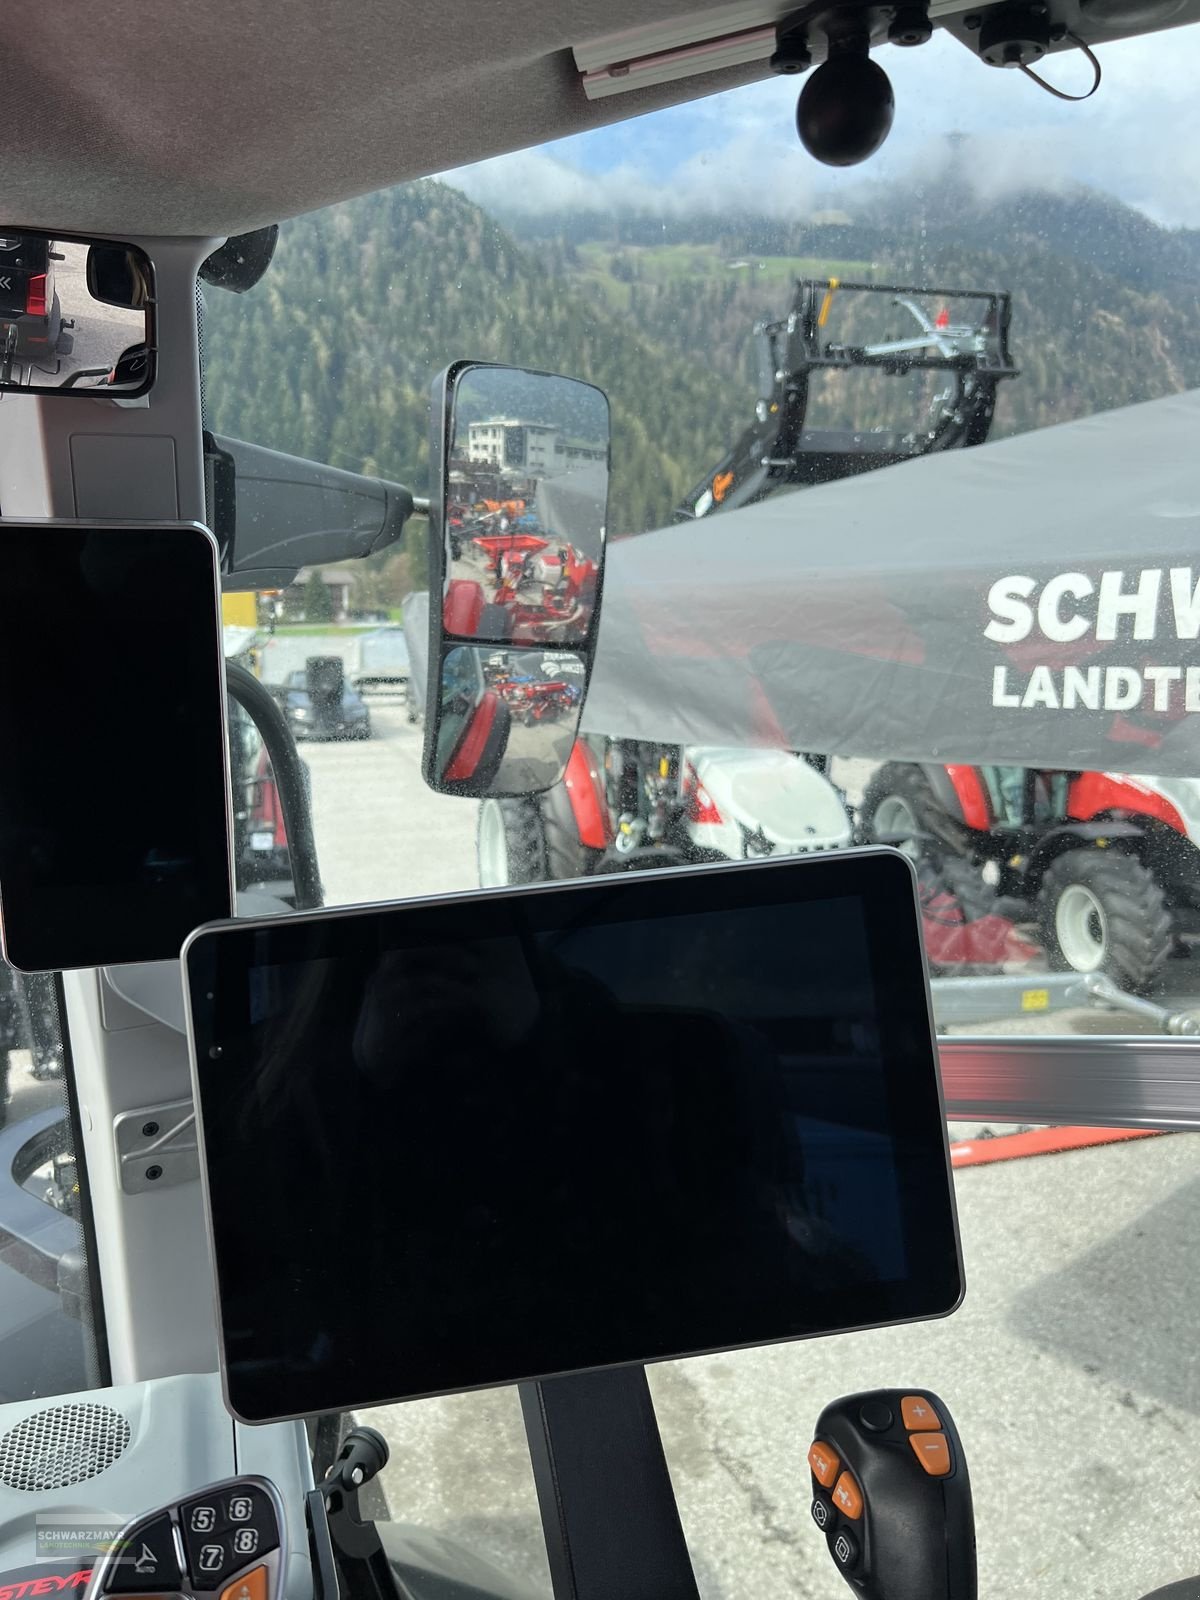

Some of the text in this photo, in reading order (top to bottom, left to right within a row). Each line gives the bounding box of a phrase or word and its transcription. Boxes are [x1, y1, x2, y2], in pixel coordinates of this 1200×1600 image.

[234, 1501, 247, 1518] 6
[197, 1511, 210, 1528] 5
[240, 1532, 252, 1550] 8
[206, 1549, 219, 1567] 7
